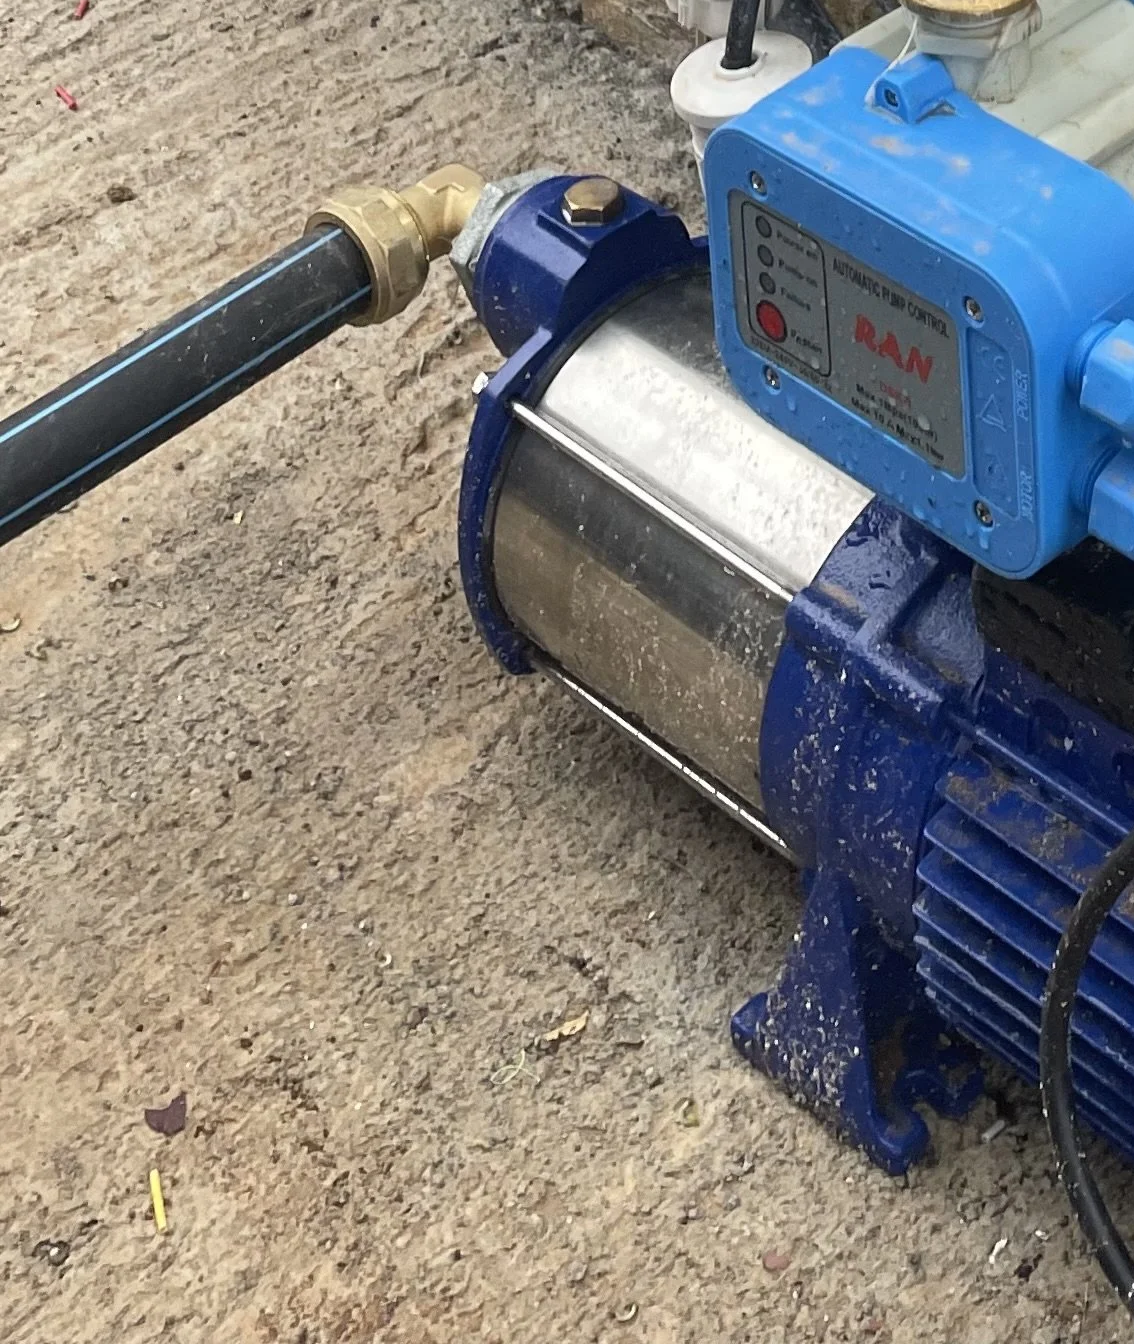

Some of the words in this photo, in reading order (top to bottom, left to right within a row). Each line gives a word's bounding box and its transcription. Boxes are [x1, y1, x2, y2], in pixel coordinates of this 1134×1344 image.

[833, 257, 881, 298] AUTOMATIC
[881, 285, 906, 311] PUMP
[907, 301, 950, 339] CONTROL
[854, 313, 934, 385] RAN
[1015, 368, 1029, 422] POWER
